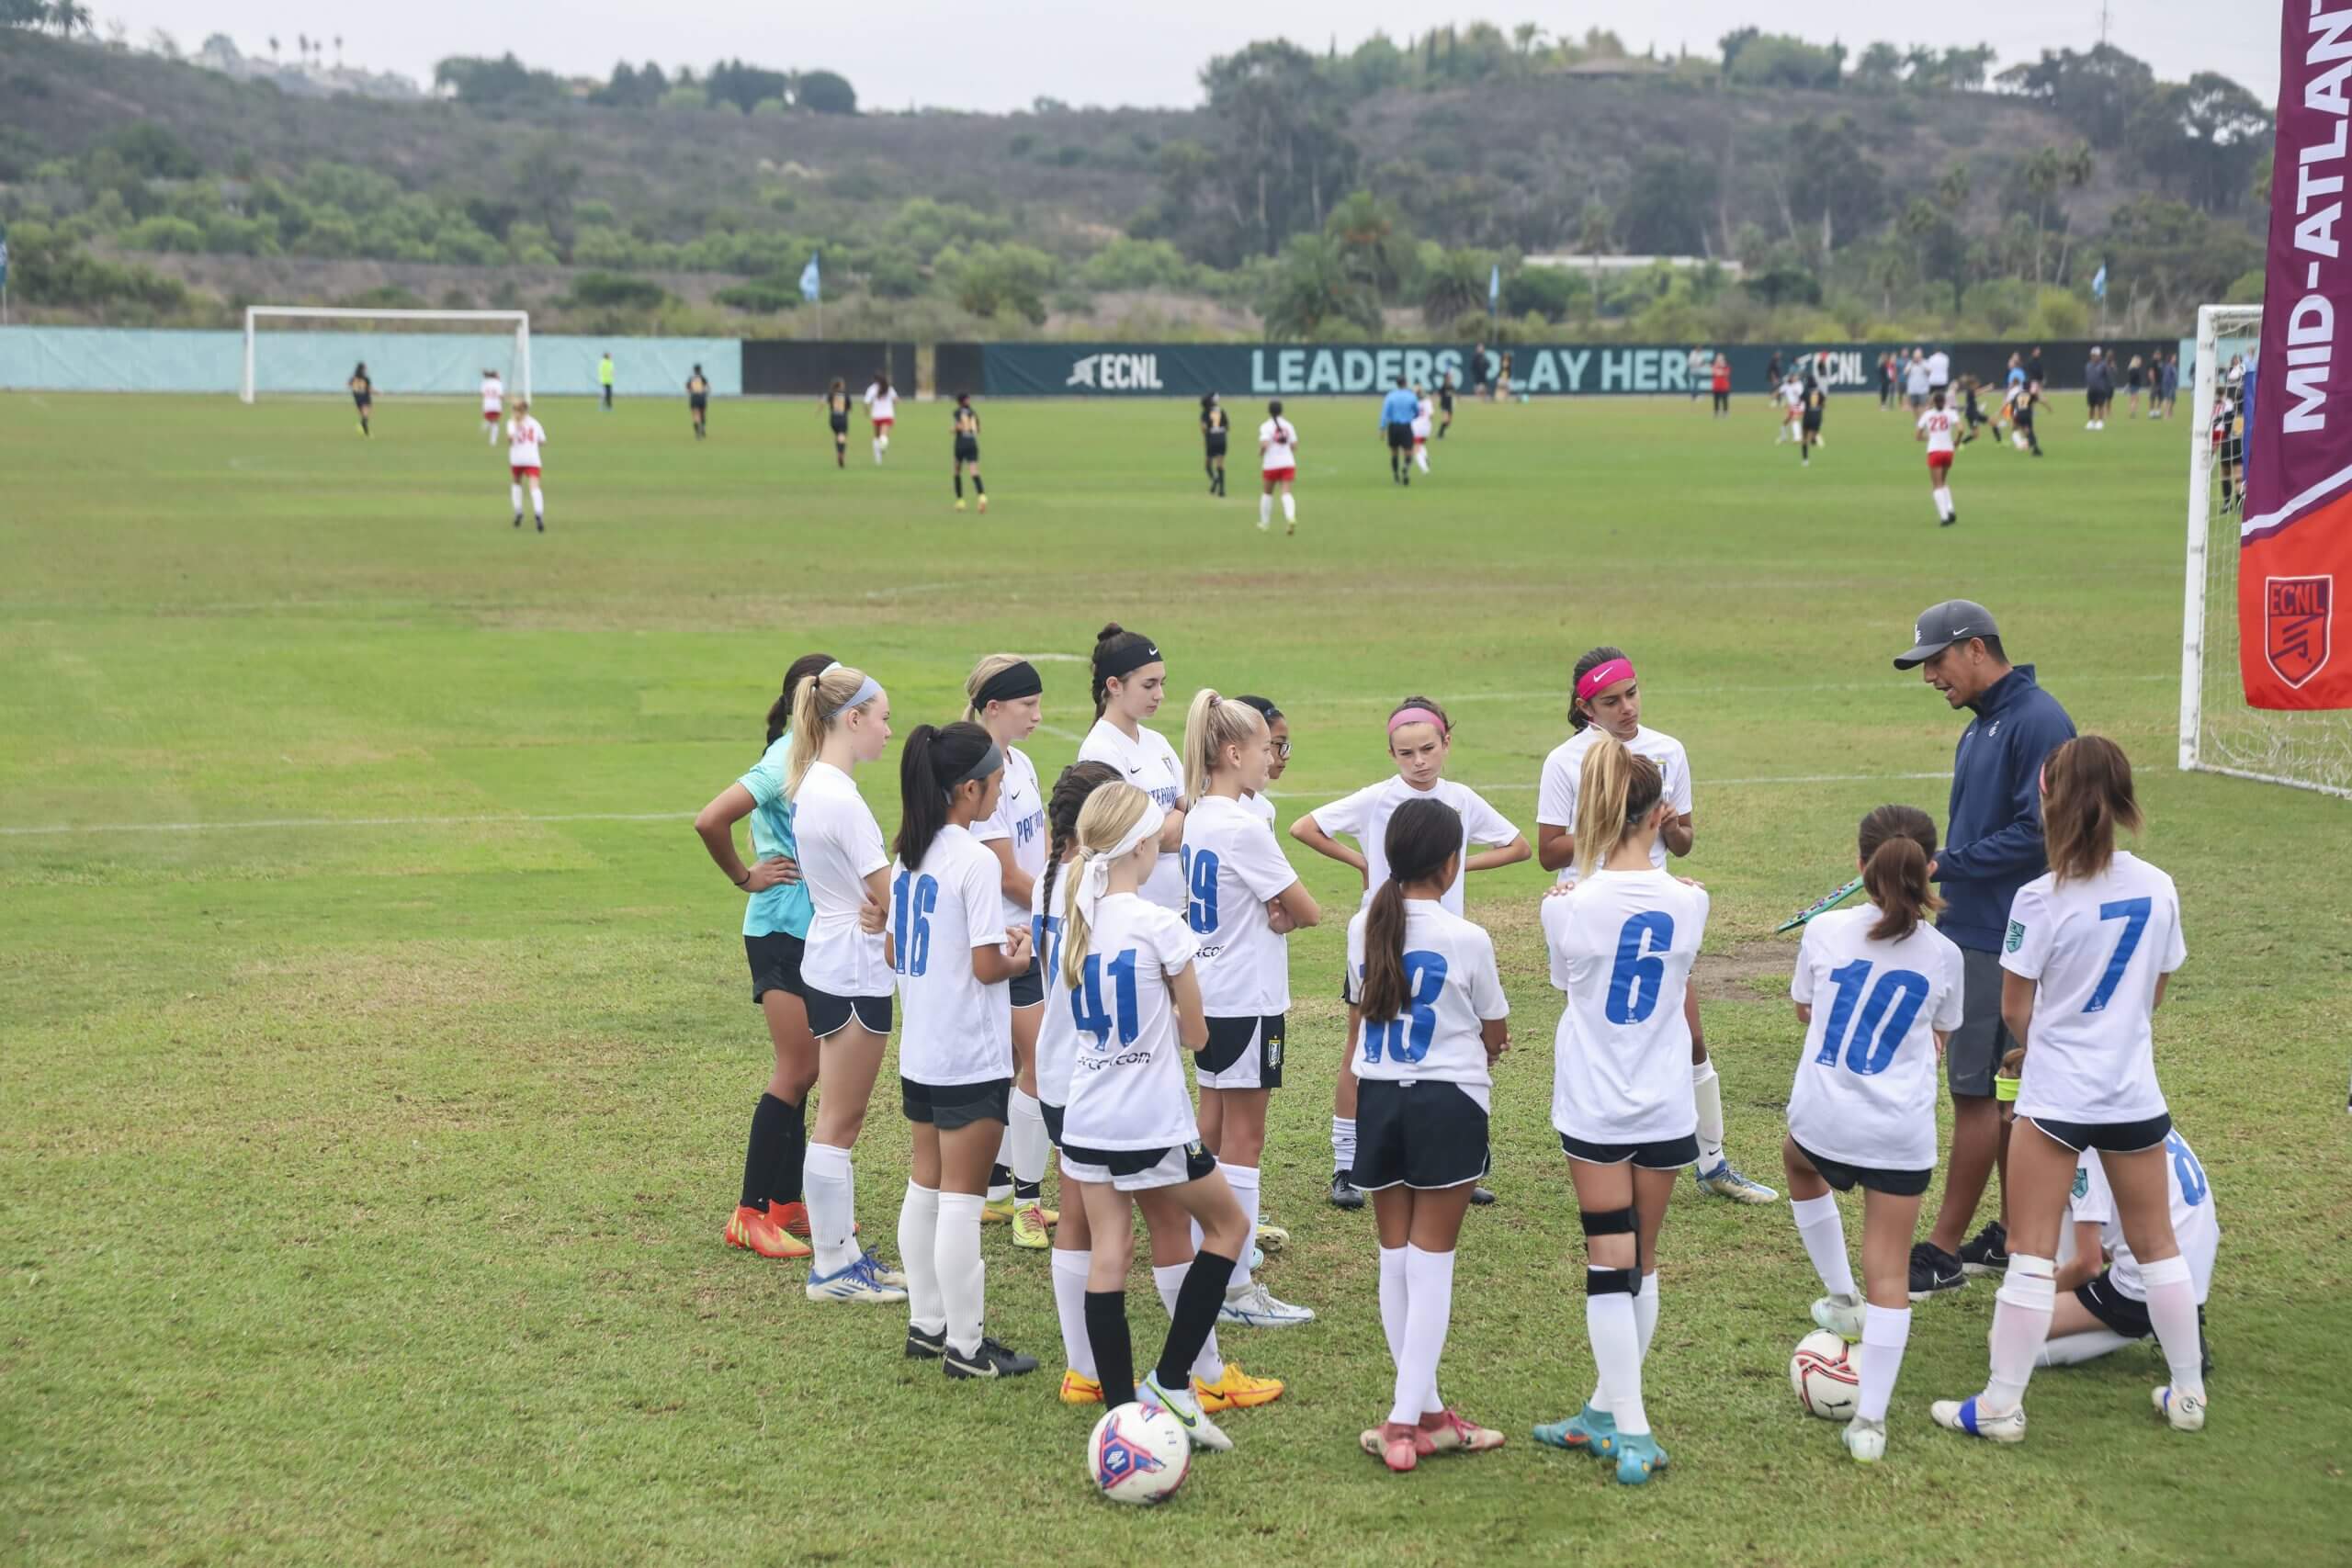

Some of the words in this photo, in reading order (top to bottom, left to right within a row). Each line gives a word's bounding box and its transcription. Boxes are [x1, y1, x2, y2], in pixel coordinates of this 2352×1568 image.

[1100, 353, 1164, 389] ECNL
[1251, 349, 1464, 392] LEADERS
[2270, 582, 2325, 615] ECNL
[893, 870, 939, 977] 16
[1605, 910, 1675, 1025] 6
[2079, 896, 2152, 1013] 7
[1070, 948, 1139, 1051] 41
[1815, 958, 1930, 1076] 10
